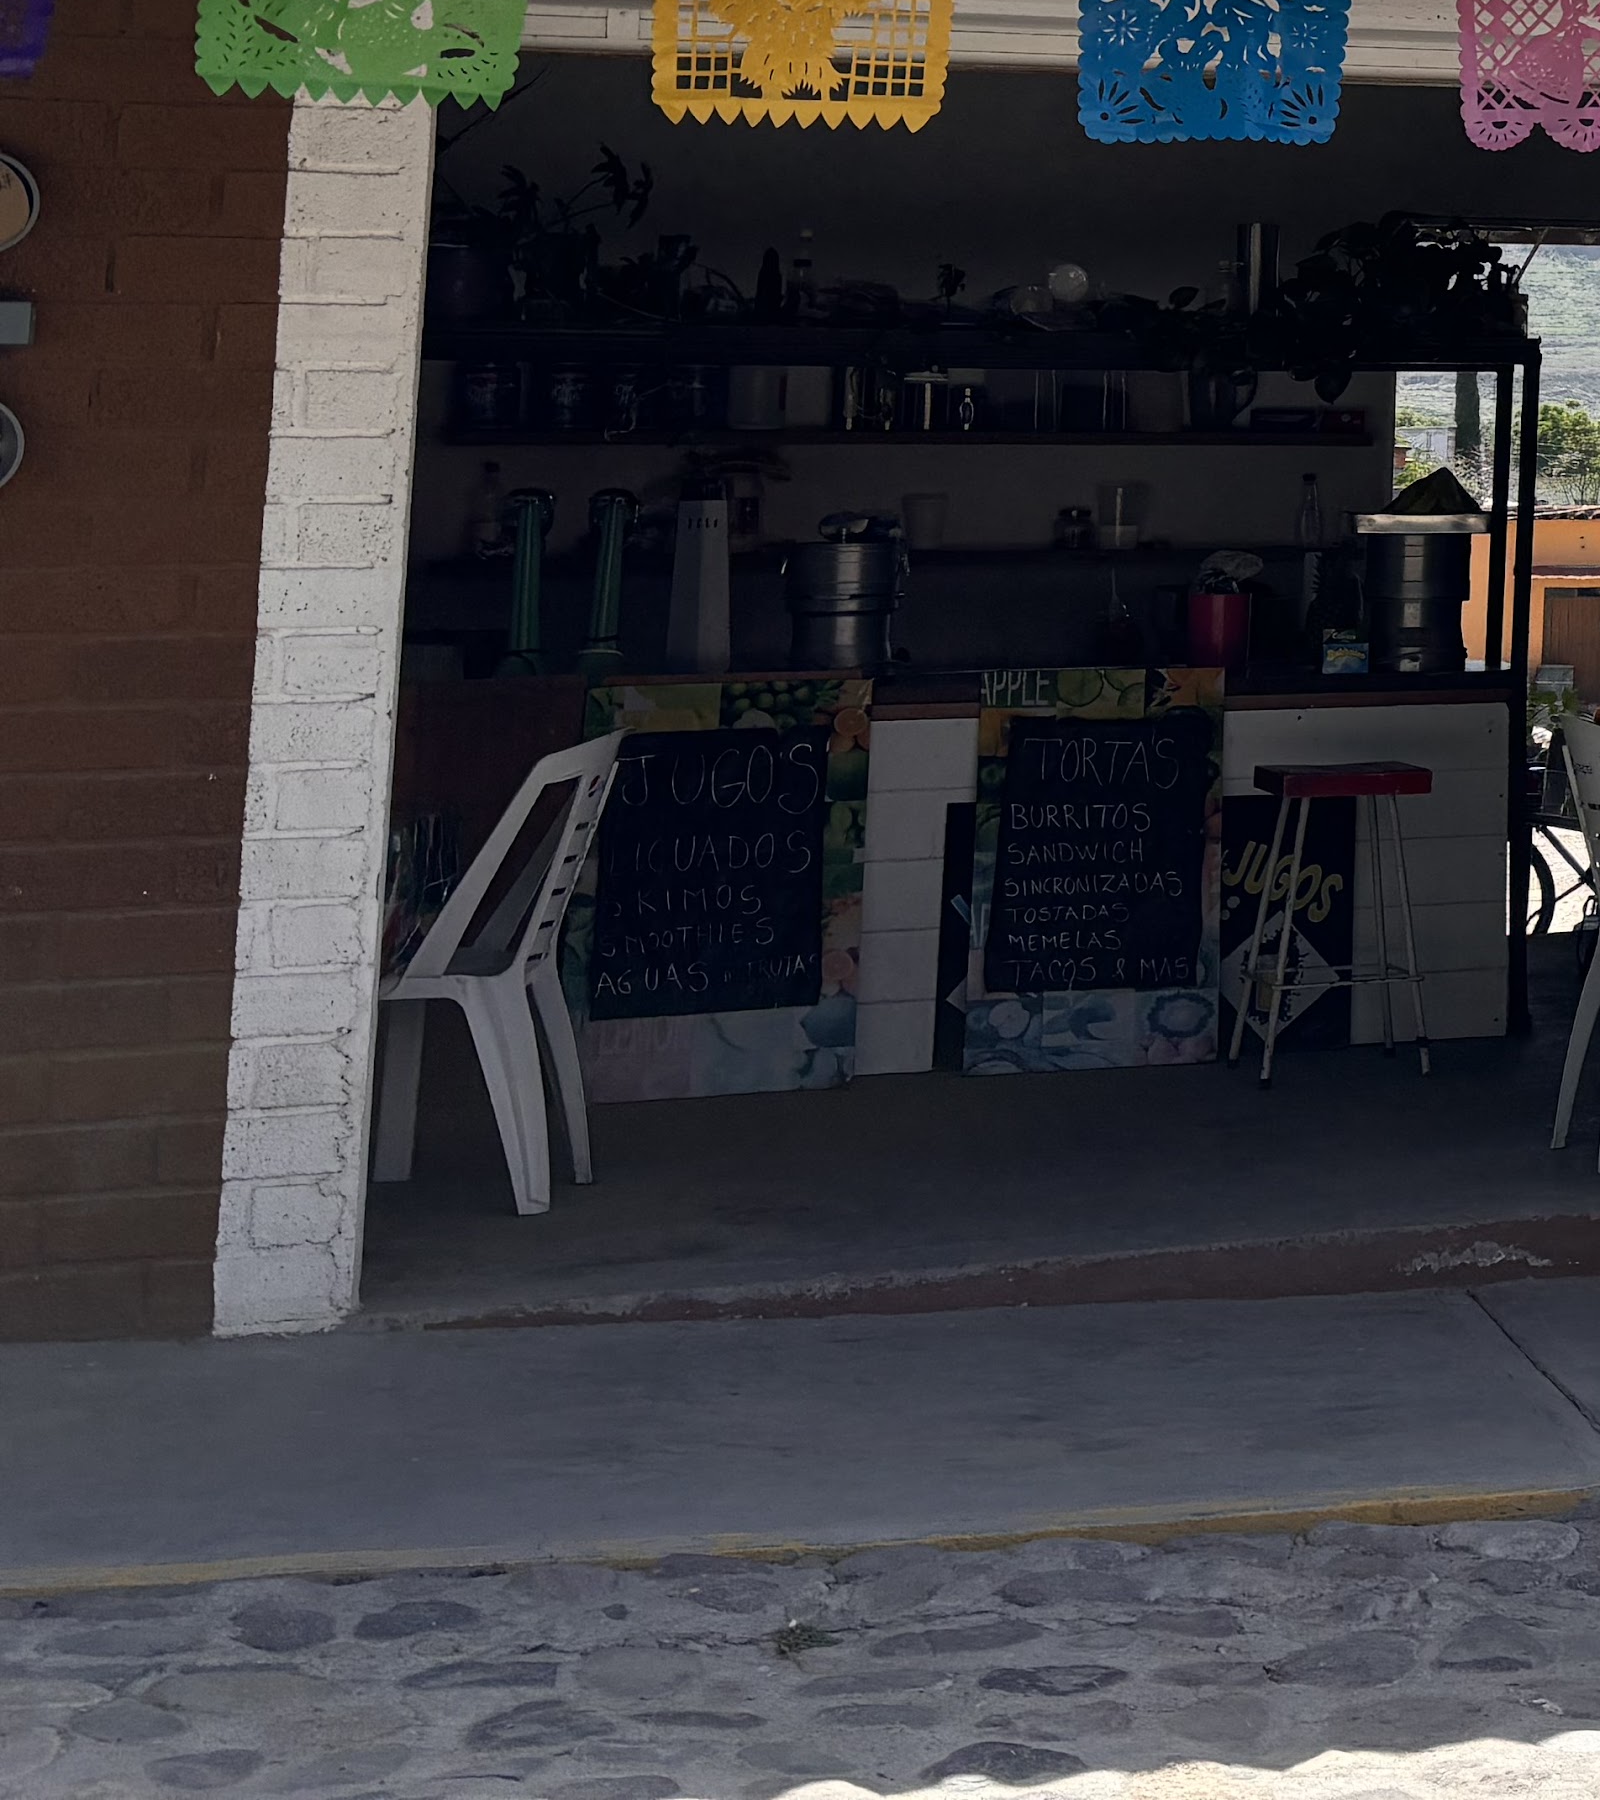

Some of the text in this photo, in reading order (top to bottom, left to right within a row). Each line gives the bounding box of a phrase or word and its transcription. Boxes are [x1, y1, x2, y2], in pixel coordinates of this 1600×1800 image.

[980, 670, 1050, 706] APPLE
[1010, 802, 1151, 834] BURRITOS
[1007, 838, 1144, 866] SANDWICH
[1002, 871, 1183, 898] SINCRONIZADAS
[1222, 840, 1344, 923] JUGOS
[1003, 902, 1130, 925] TOSTADAS
[1007, 929, 1122, 953] MEMELAS
[594, 961, 710, 998] AGUAS
[1001, 956, 1096, 989] TACOS
